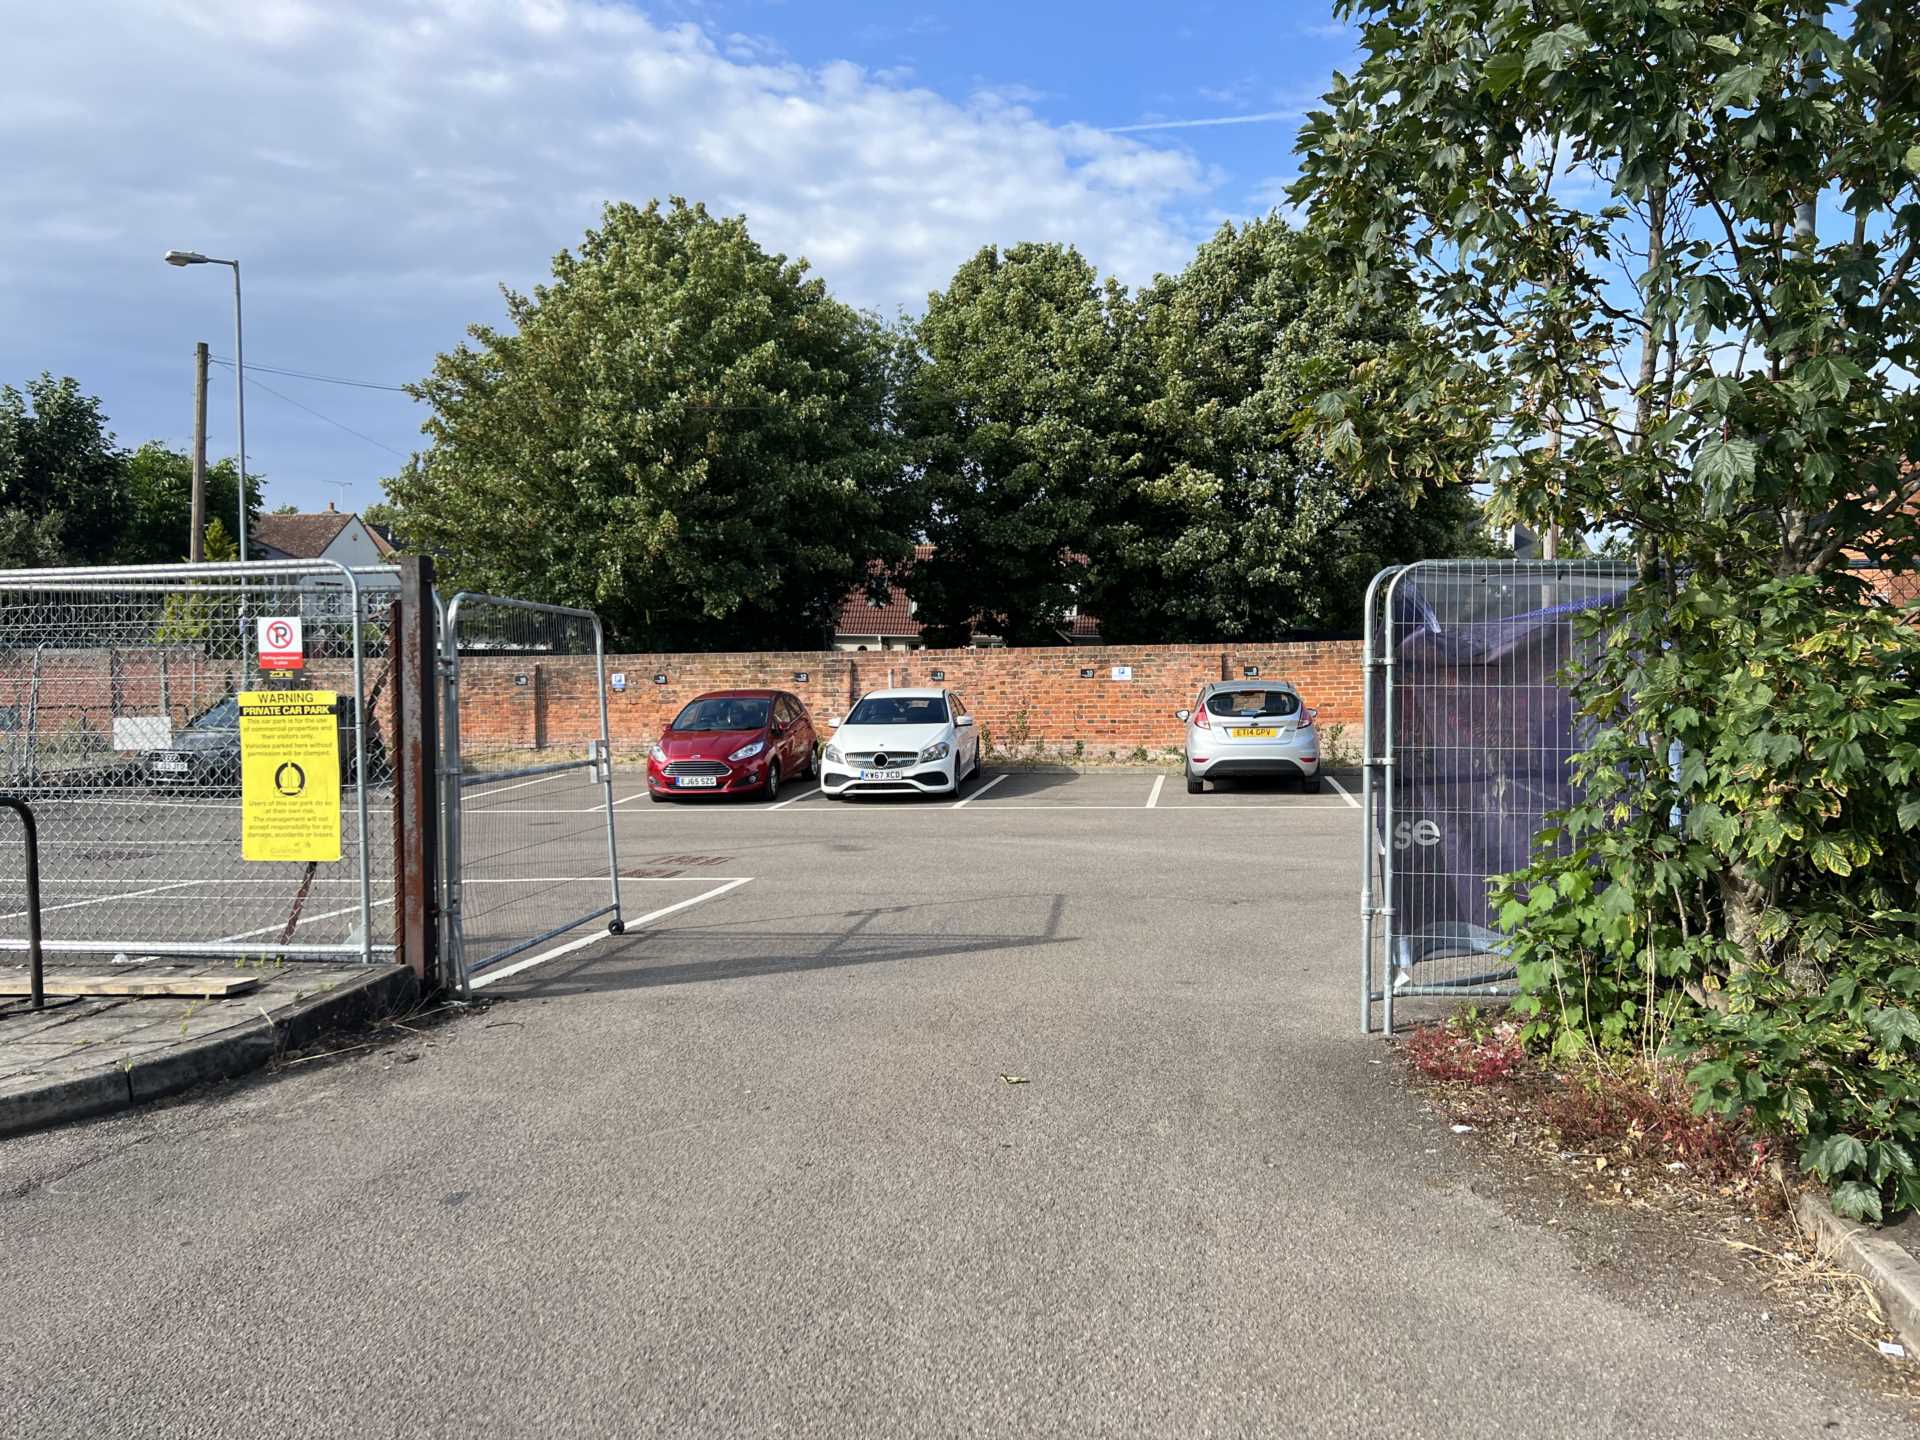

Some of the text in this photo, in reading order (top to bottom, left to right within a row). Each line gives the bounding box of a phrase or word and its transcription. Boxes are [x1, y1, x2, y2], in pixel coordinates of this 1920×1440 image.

[258, 693, 314, 704] WARNING
[243, 705, 330, 715] PRIVATE CAR PARK
